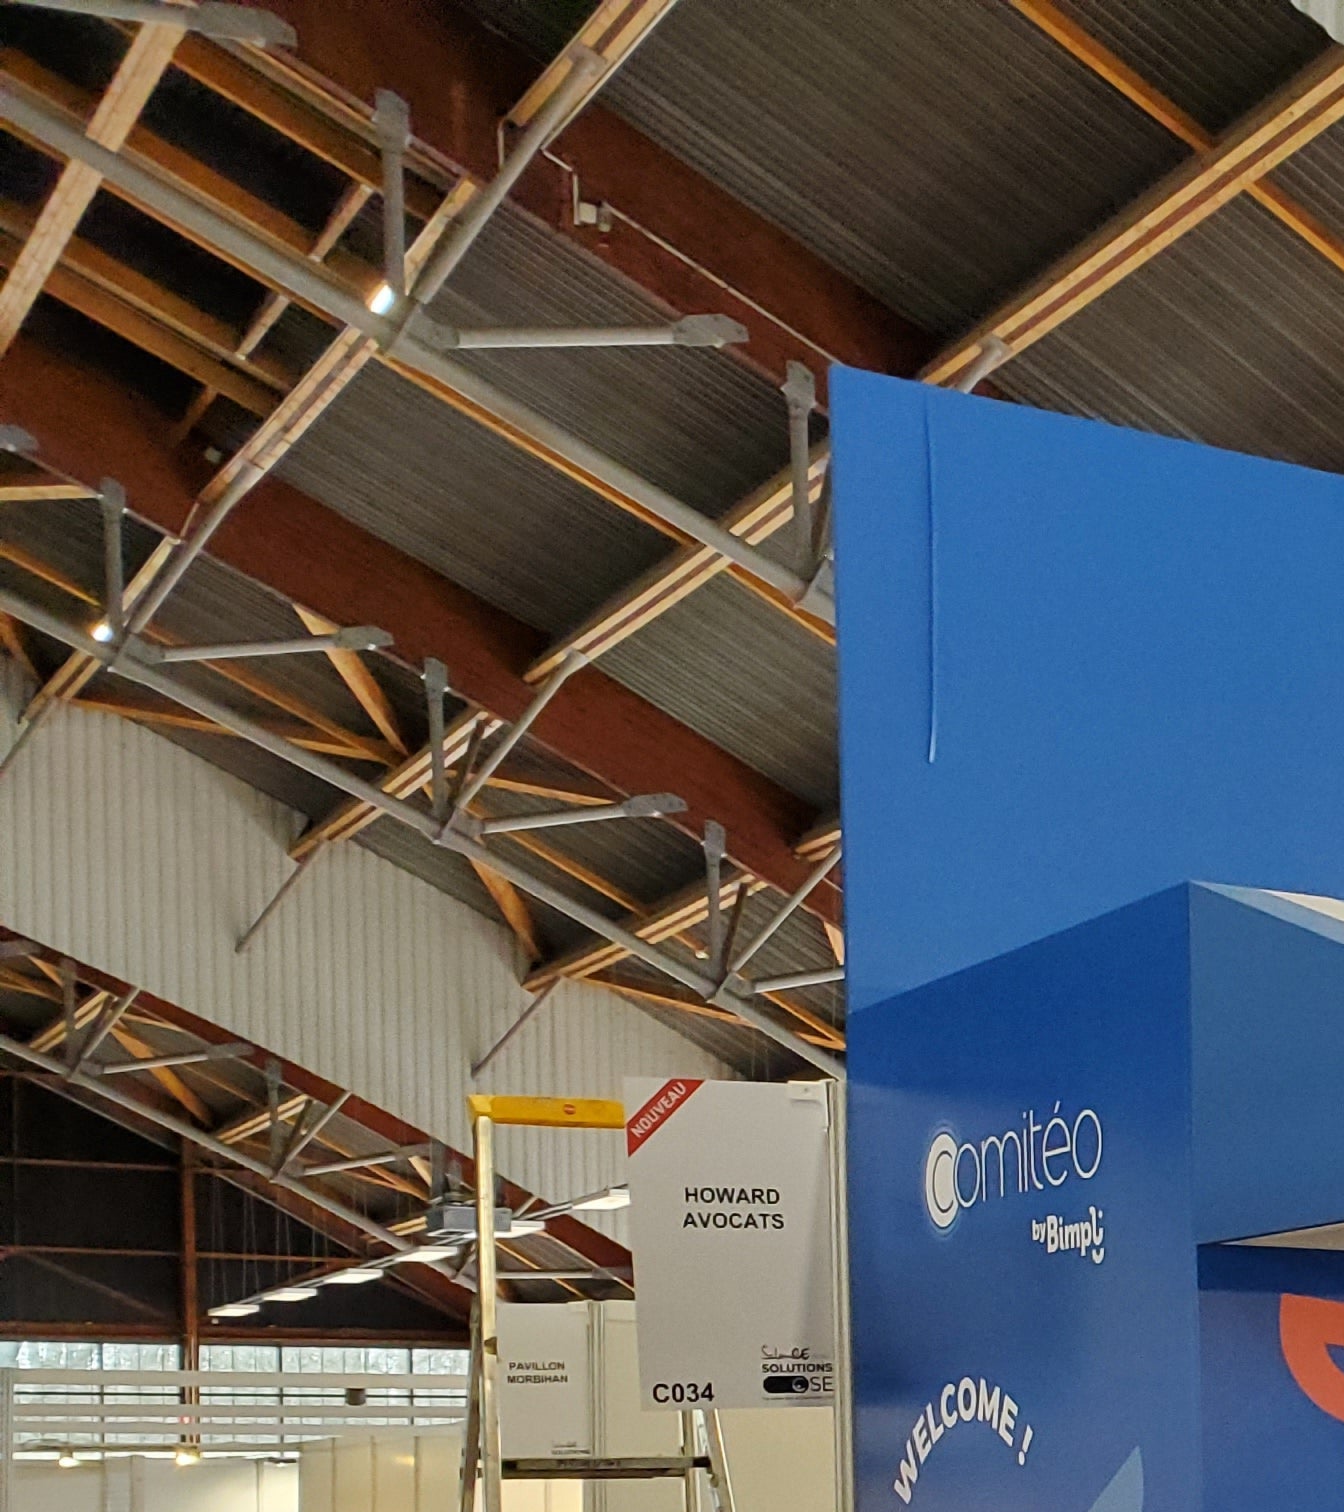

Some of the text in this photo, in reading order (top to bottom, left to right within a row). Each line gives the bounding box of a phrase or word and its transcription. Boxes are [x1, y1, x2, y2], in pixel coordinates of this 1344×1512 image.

[630, 1081, 687, 1139] NOUVEAU
[925, 1100, 1102, 1228] Comitéo
[684, 1187, 781, 1205] HOWARD
[682, 1212, 785, 1230] AVOCATS
[1031, 1219, 1046, 1243] by
[508, 1361, 566, 1371] PAVILLON
[761, 1363, 833, 1374] SOLUTIONS
[506, 1374, 569, 1384] MORBIHAN
[652, 1381, 715, 1404] C034
